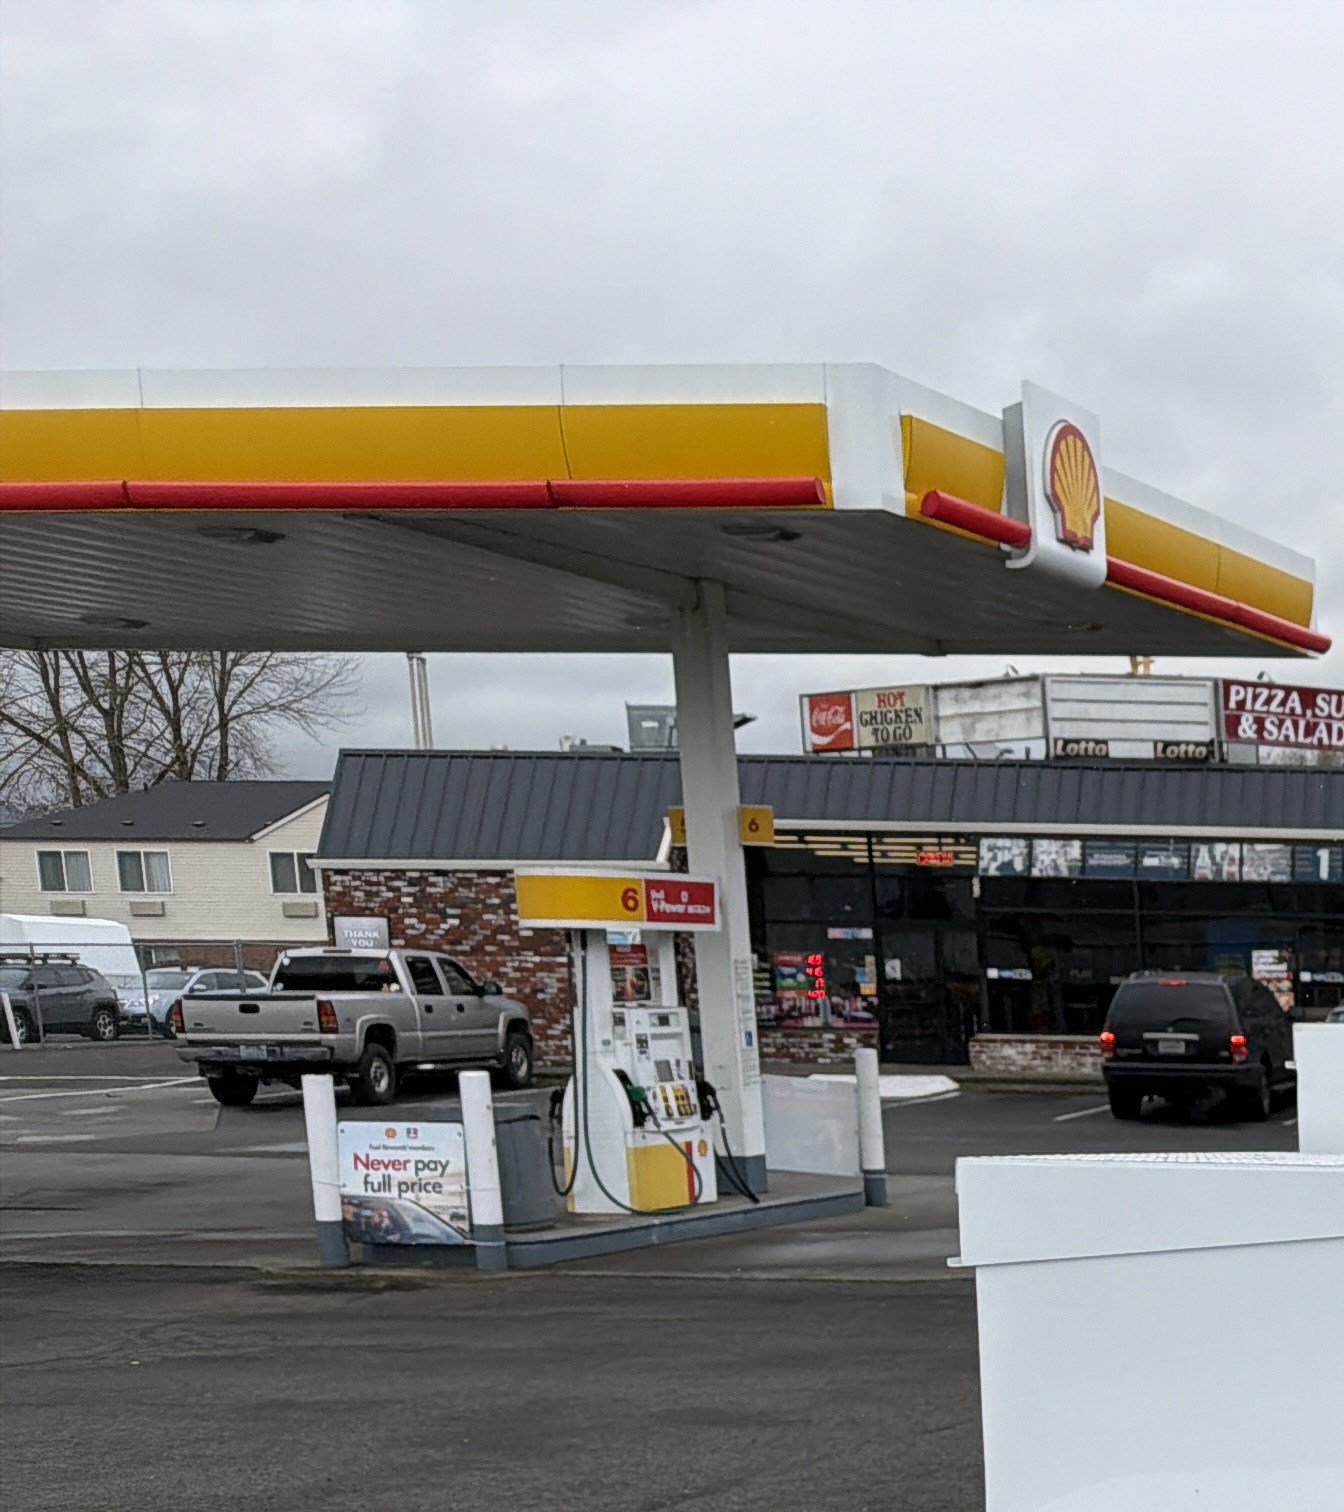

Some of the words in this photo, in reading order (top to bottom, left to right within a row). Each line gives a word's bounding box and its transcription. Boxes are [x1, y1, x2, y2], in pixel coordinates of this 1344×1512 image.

[876, 691, 906, 709] HOT
[859, 707, 923, 728] CHICKEN
[1237, 712, 1258, 740] &
[871, 725, 890, 744] TO
[892, 725, 913, 742] GO
[1055, 737, 1108, 757] Lotto
[1155, 742, 1208, 759] Lotto
[1316, 848, 1330, 881] 1
[620, 887, 640, 912] 6
[342, 929, 379, 938] THANK
[351, 938, 374, 947] YOU
[352, 1152, 412, 1172] Never
[414, 1158, 450, 1178] pay
[363, 1172, 392, 1194] full
[397, 1177, 443, 1200] price
